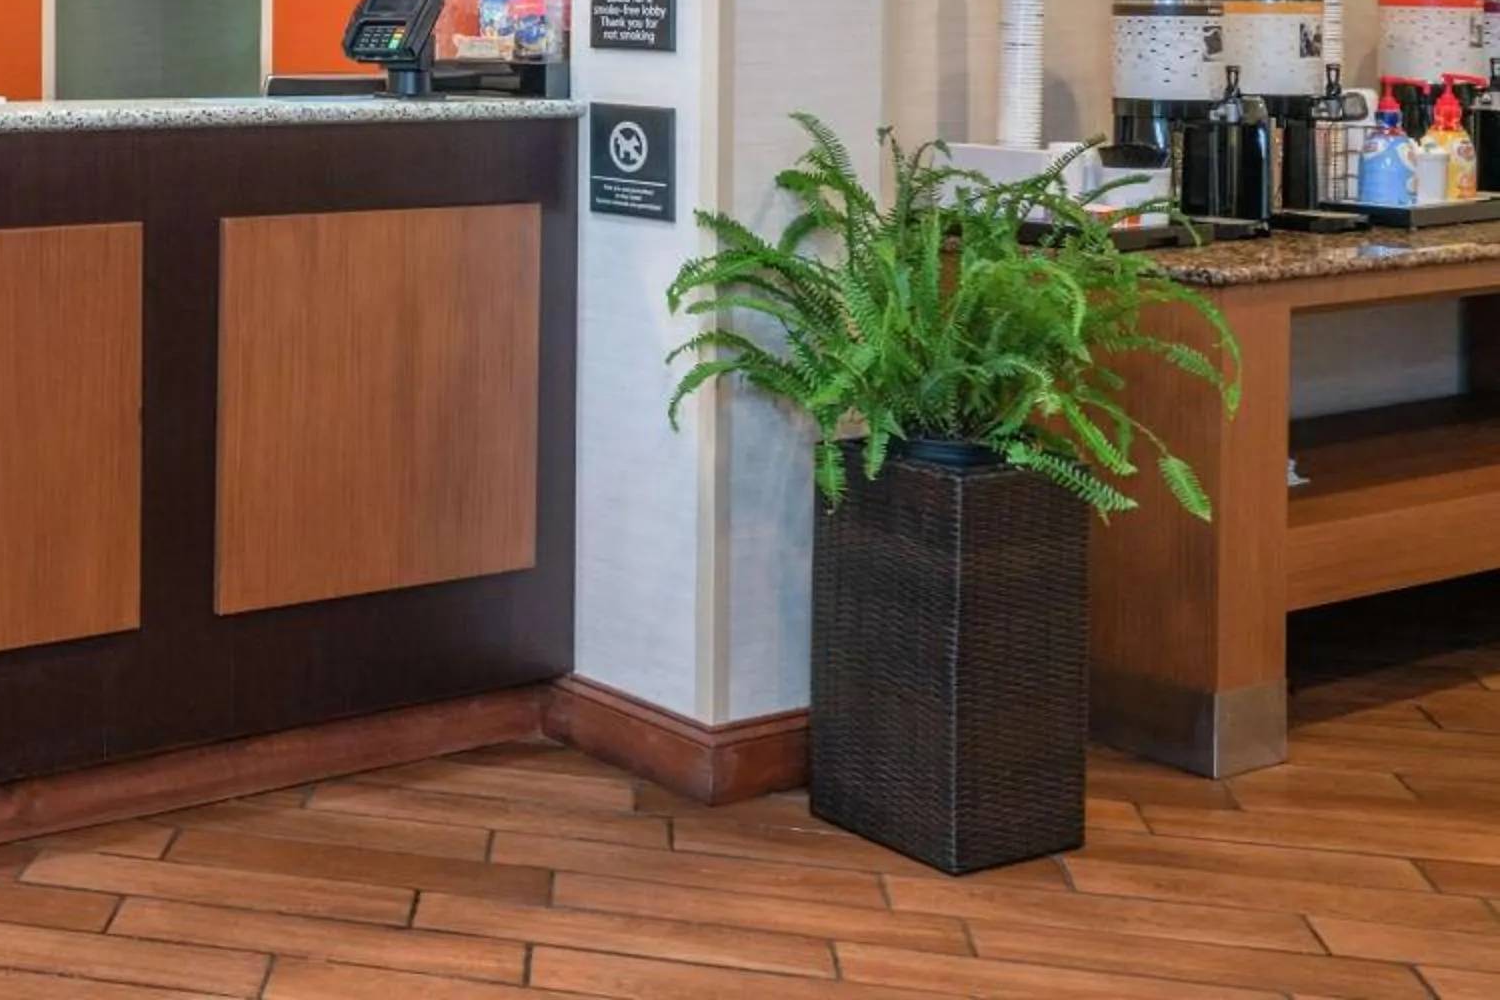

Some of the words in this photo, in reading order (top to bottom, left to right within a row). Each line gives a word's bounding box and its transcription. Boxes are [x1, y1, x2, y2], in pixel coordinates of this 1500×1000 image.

[641, 4, 666, 19] lobby
[601, 16, 626, 28] Thank
[627, 19, 644, 31] you
[645, 17, 659, 29] for
[619, 31, 655, 45] smoking
